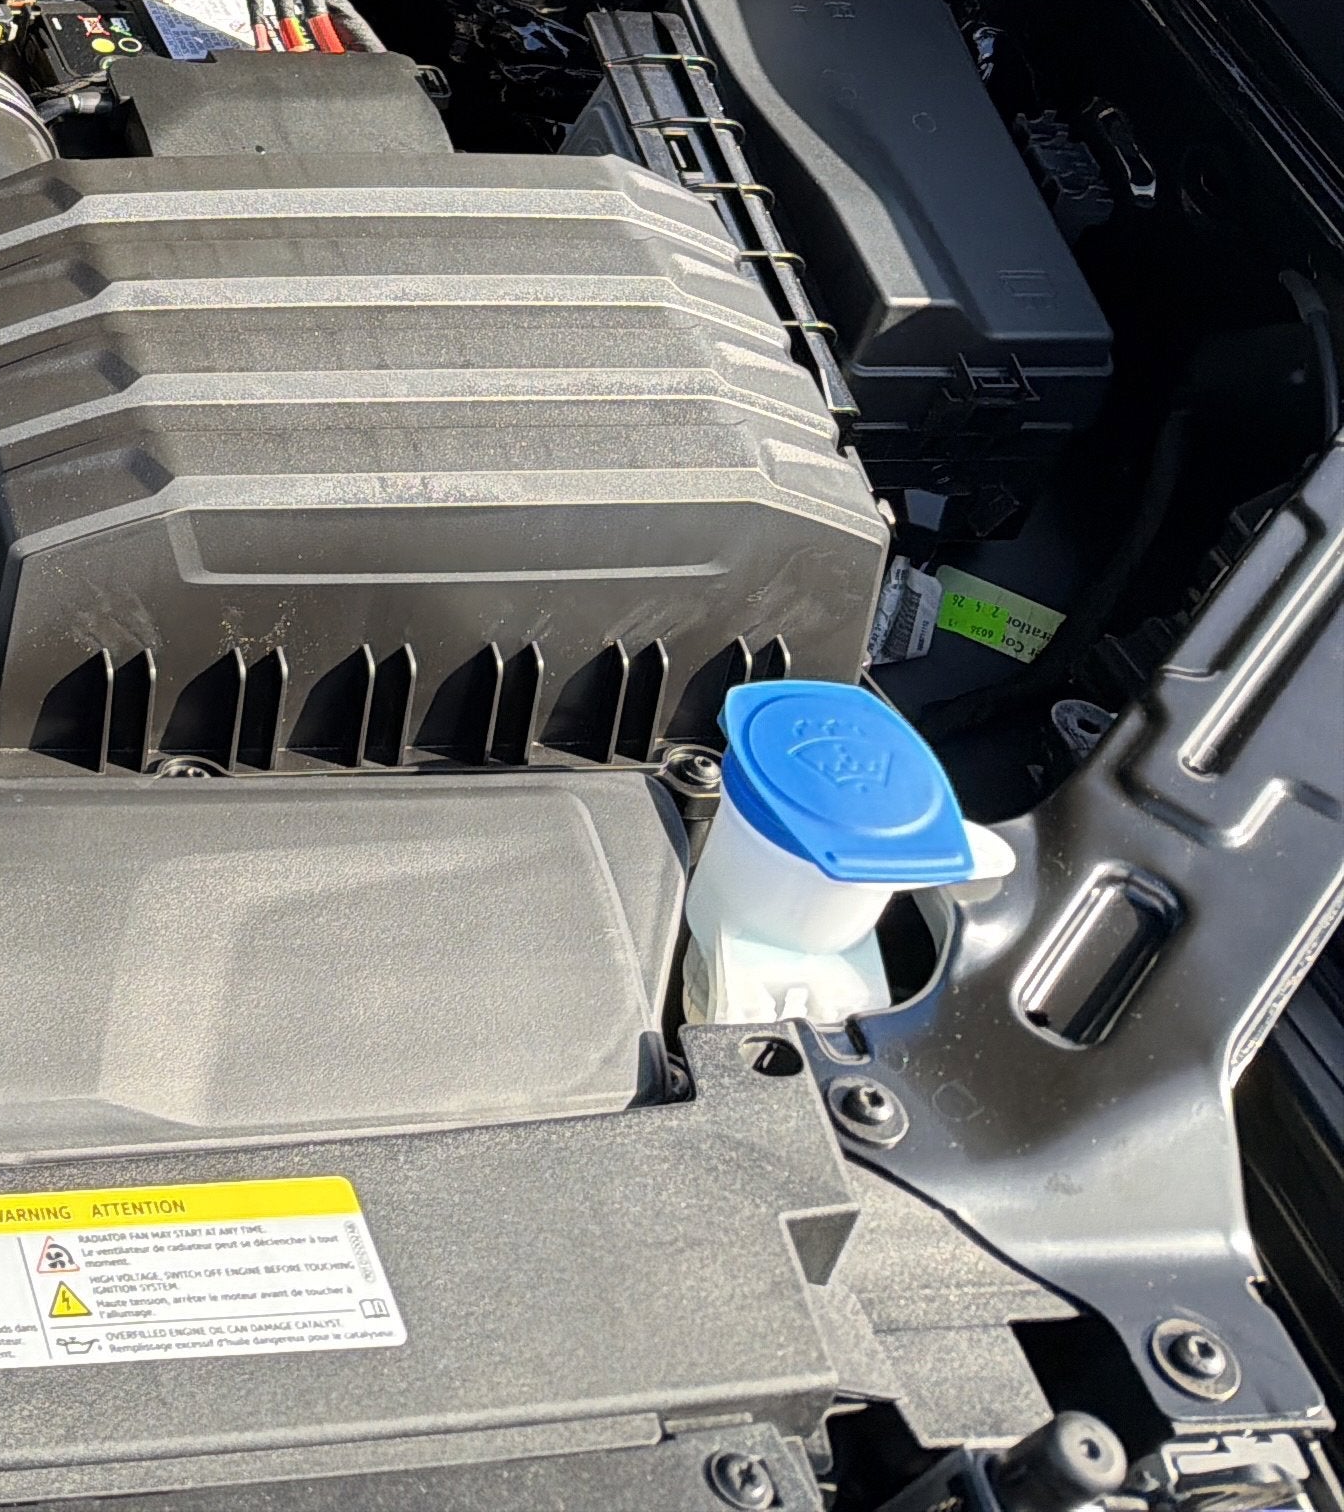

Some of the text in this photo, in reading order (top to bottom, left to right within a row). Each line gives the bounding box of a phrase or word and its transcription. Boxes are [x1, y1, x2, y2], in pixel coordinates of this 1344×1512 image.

[91, 1199, 186, 1218] ATTENTION
[78, 1232, 127, 1243] RADIATOR
[129, 1232, 149, 1240] FAN
[151, 1231, 172, 1239] MAY
[173, 1229, 203, 1239] START
[96, 1245, 150, 1255] ventilateur
[152, 1244, 165, 1253] de
[215, 1240, 238, 1251] peut
[317, 1235, 339, 1243] tout
[89, 1261, 355, 1284] HIGH SWITCH OFF ENGINE BEFORE TOUCHING
[92, 1284, 137, 1294] IGNITION
[96, 1299, 127, 1307] Haute
[209, 1293, 219, 1301] le
[221, 1292, 257, 1301] moteur
[260, 1291, 289, 1299] avant
[291, 1289, 303, 1297] de
[304, 1287, 343, 1296] toucher
[15, 1324, 38, 1333] dans
[105, 1329, 167, 1340] OVERFILLED
[169, 1327, 206, 1337] ENGINE
[209, 1326, 225, 1335] OIL
[227, 1324, 249, 1333] CAN
[250, 1322, 291, 1332] DAMAGE
[109, 1342, 172, 1353] Remplissage
[253, 1335, 305, 1345] dangereux
[307, 1333, 330, 1343] pour
